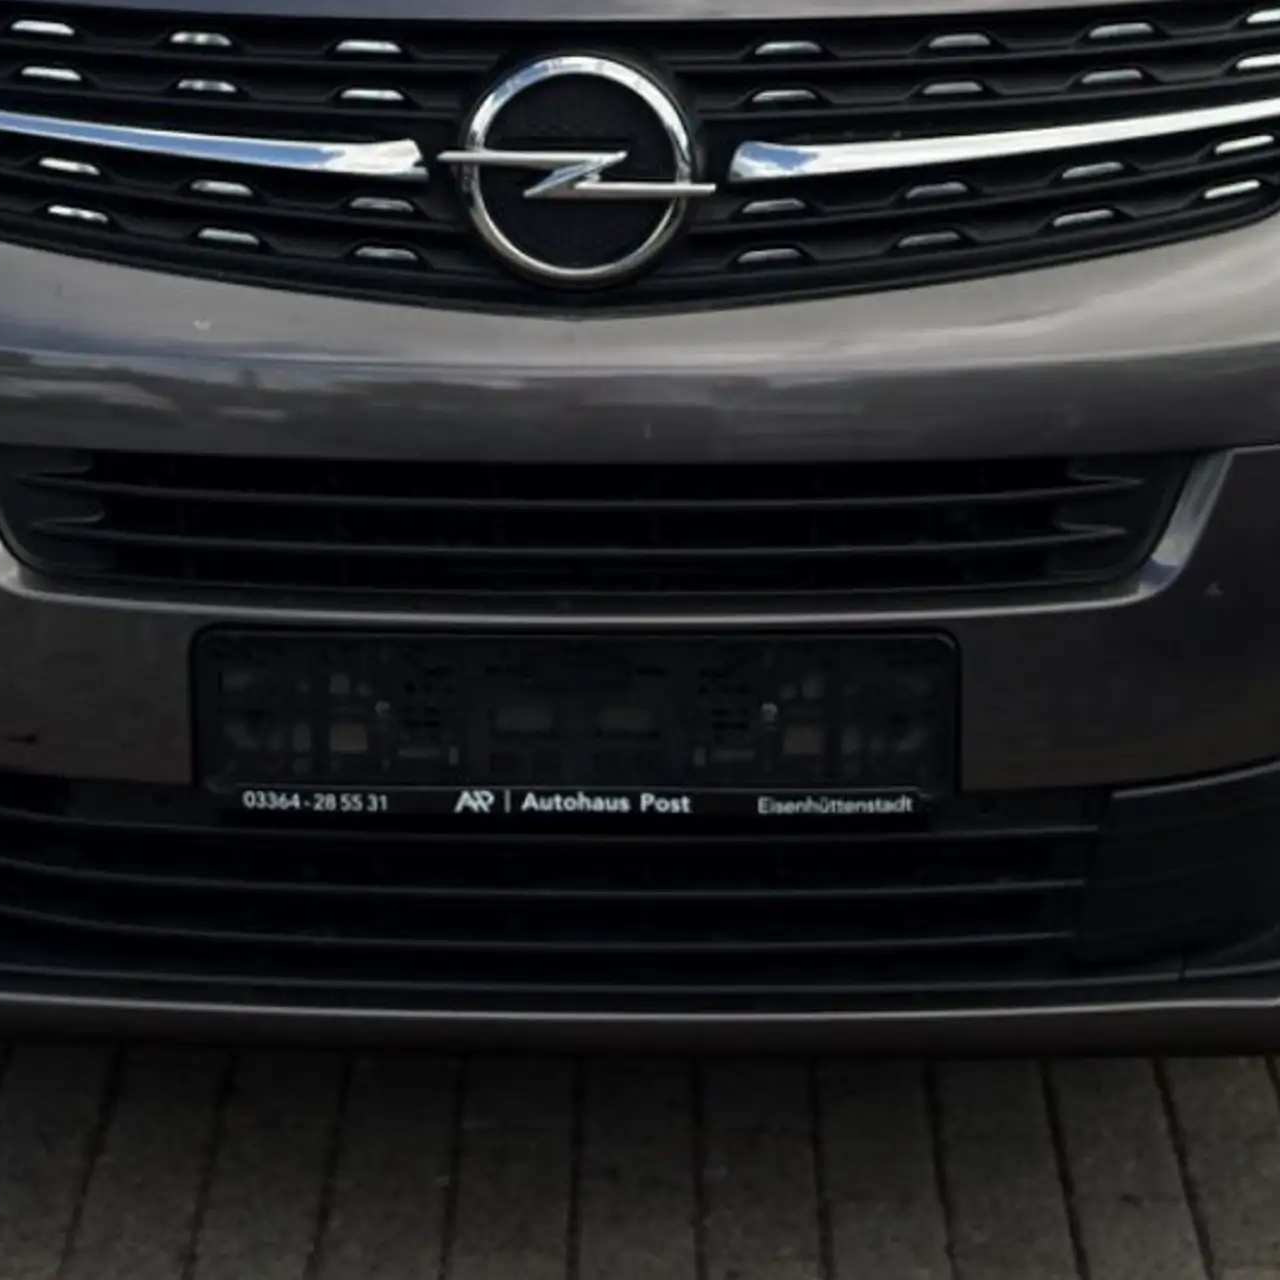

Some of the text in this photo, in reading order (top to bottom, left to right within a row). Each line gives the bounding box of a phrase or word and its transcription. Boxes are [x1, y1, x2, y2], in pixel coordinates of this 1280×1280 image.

[340, 793, 363, 812] 55
[366, 794, 388, 812] 31
[521, 791, 630, 813] Autohaus
[640, 793, 691, 813] Post
